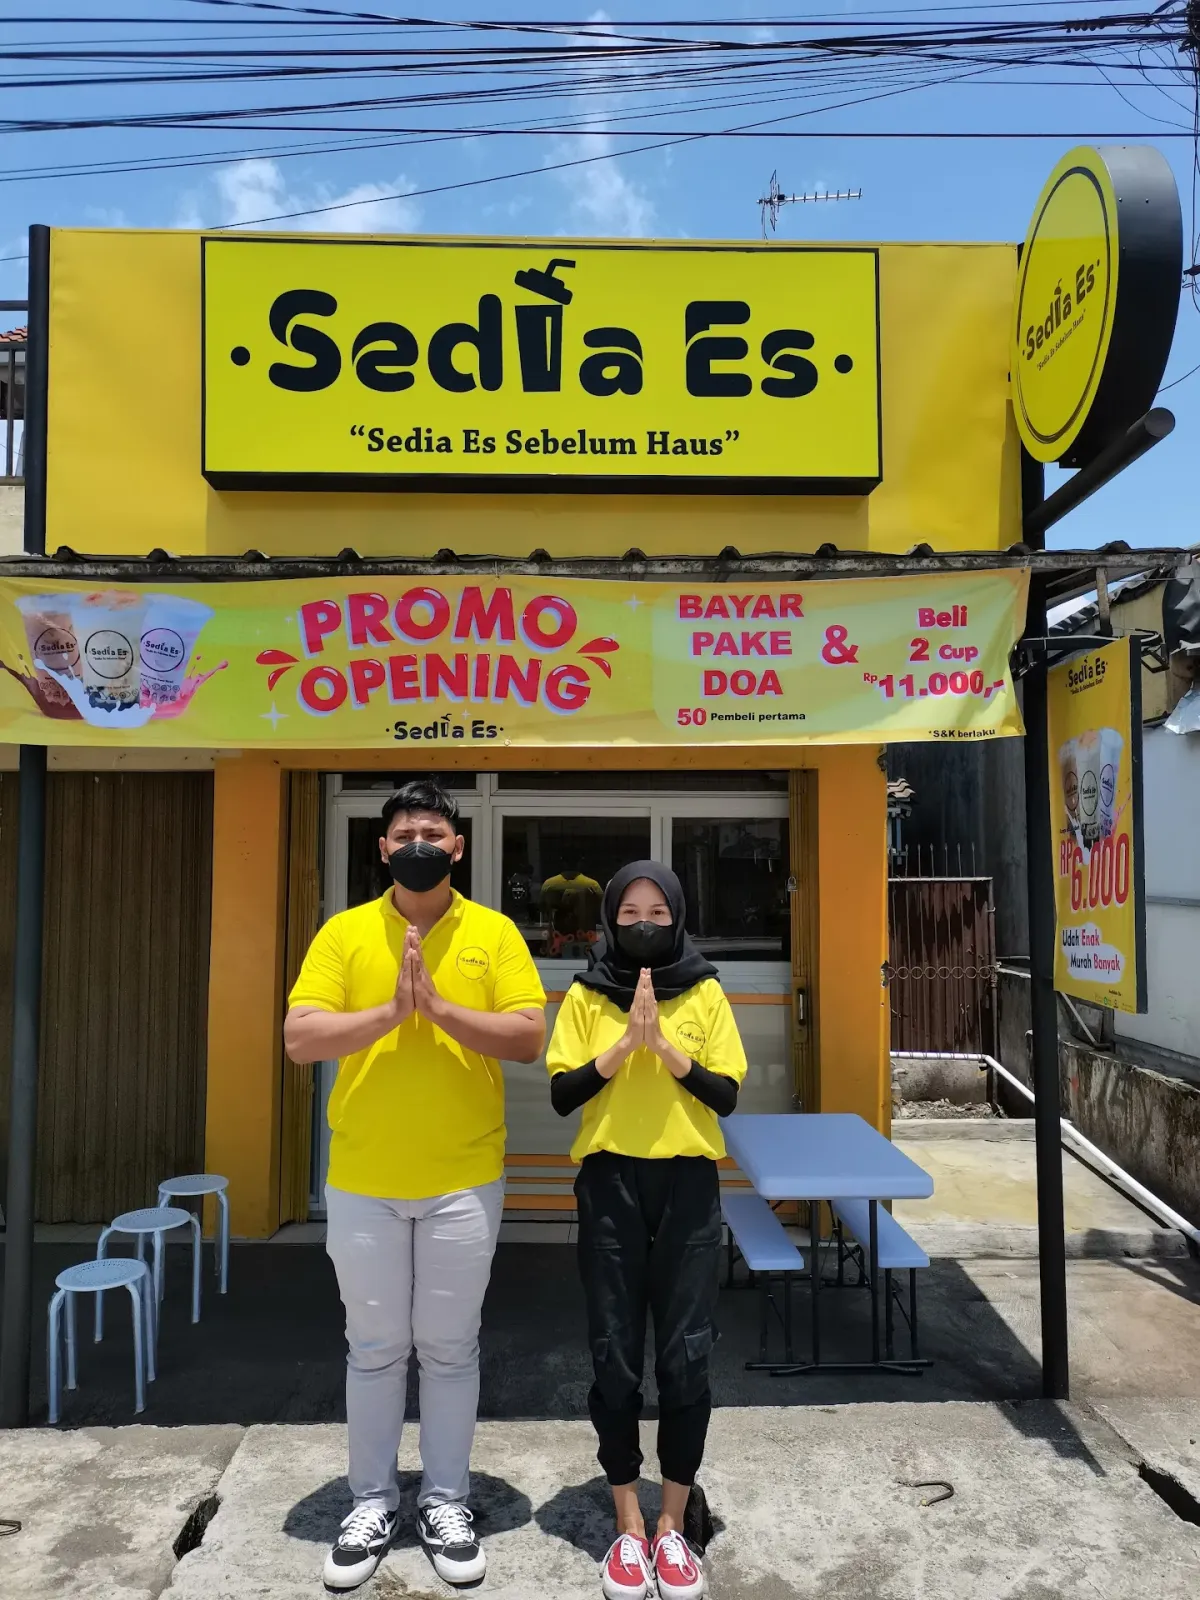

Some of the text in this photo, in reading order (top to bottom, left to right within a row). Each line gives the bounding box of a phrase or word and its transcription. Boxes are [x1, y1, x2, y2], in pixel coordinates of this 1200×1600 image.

[1026, 263, 1095, 361] Sedia Es
[268, 259, 819, 398] Sedia Es
[462, 429, 496, 454] Es
[505, 429, 637, 456] Sebelum
[678, 594, 804, 619] BAYAR
[917, 605, 968, 628] Beli
[299, 586, 578, 657] PROMO
[691, 631, 793, 656] PAKE
[821, 625, 859, 665] &
[909, 638, 979, 662] 2 Cup
[1095, 657, 1106, 676] Es
[299, 653, 592, 713] OPENING
[703, 670, 784, 696] DOA
[863, 670, 1005, 699] Rp 11.000,-
[394, 713, 498, 740] Sedia Es
[677, 708, 806, 726] 50 Pembeli pertama
[957, 728, 996, 738] berlaku
[1060, 832, 1130, 911] RP 6.000
[1062, 928, 1100, 947] Udah Enak
[1070, 952, 1121, 975] Murah Banyak
